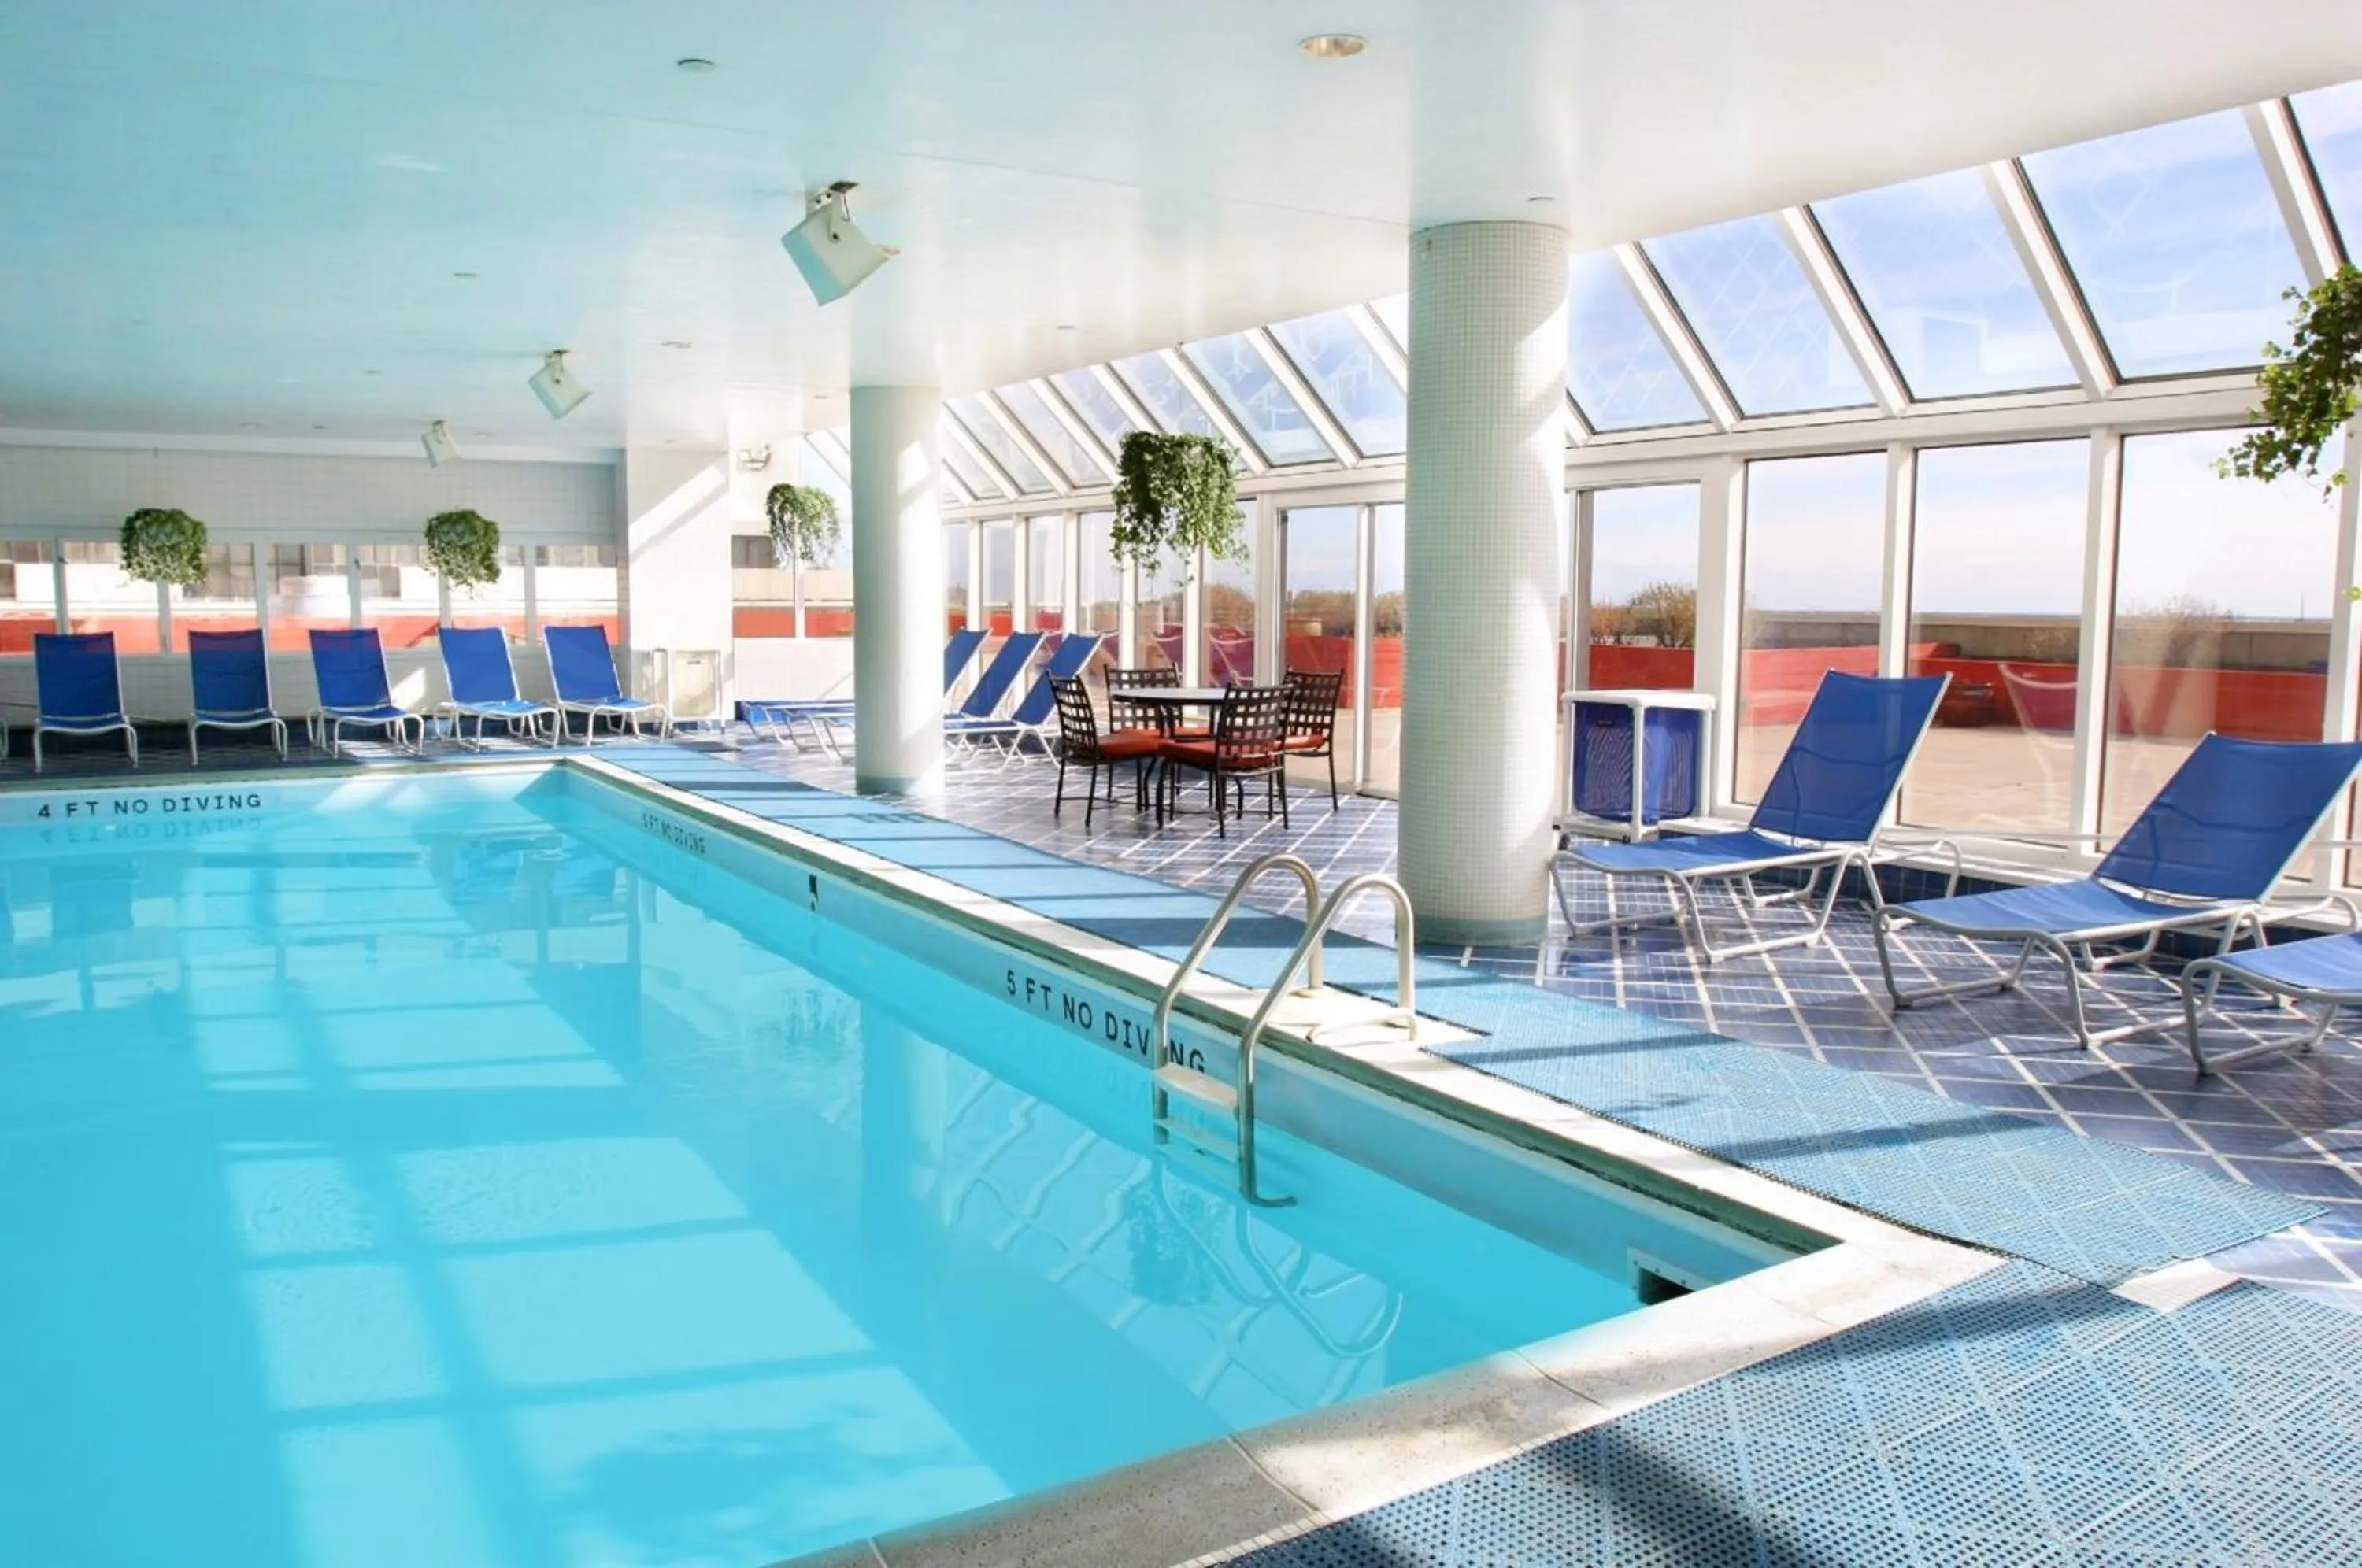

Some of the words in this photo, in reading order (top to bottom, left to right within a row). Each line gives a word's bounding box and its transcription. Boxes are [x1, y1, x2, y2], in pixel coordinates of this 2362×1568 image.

[37, 803, 51, 818] 4
[66, 801, 100, 818] FT
[113, 798, 148, 814] NO
[162, 793, 261, 813] DIVING
[1006, 970, 1017, 997] 5
[1025, 977, 1052, 1011] FT
[1063, 993, 1093, 1030] NO
[1105, 1011, 1205, 1074] DIVNG
